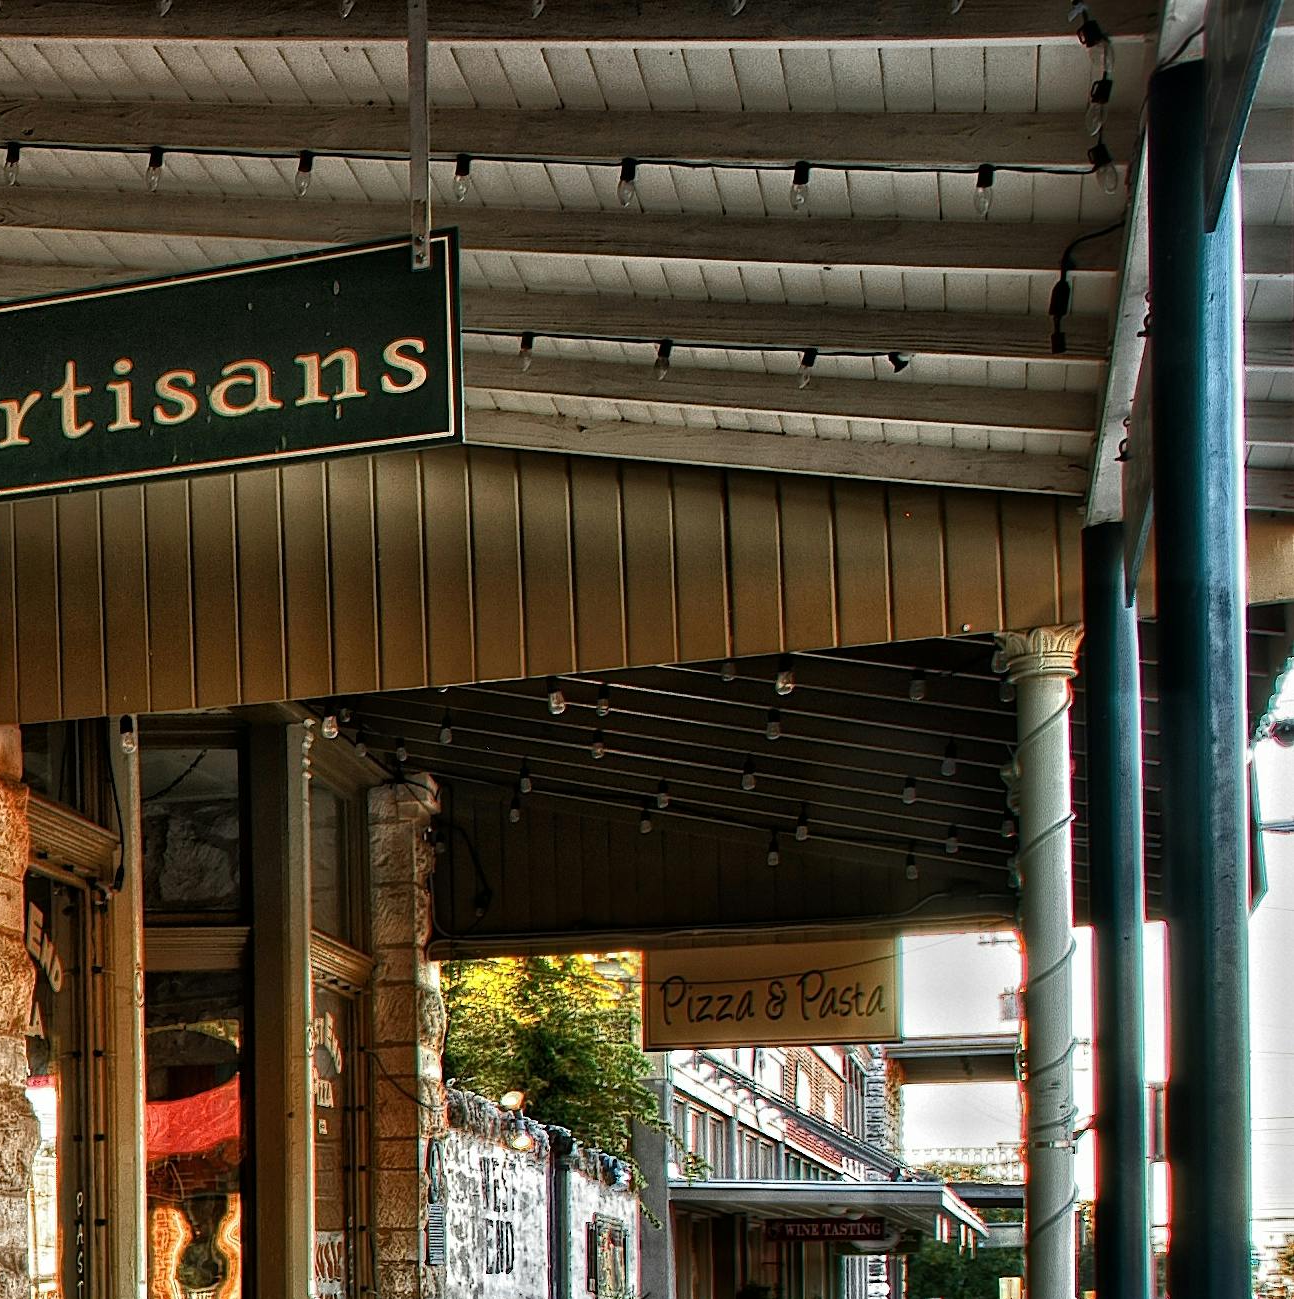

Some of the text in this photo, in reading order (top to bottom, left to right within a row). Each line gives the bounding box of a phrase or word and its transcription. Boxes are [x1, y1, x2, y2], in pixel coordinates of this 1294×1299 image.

[659, 969, 887, 1026] Pizza & Pasta
[784, 1222, 882, 1237] WINE TASTING
